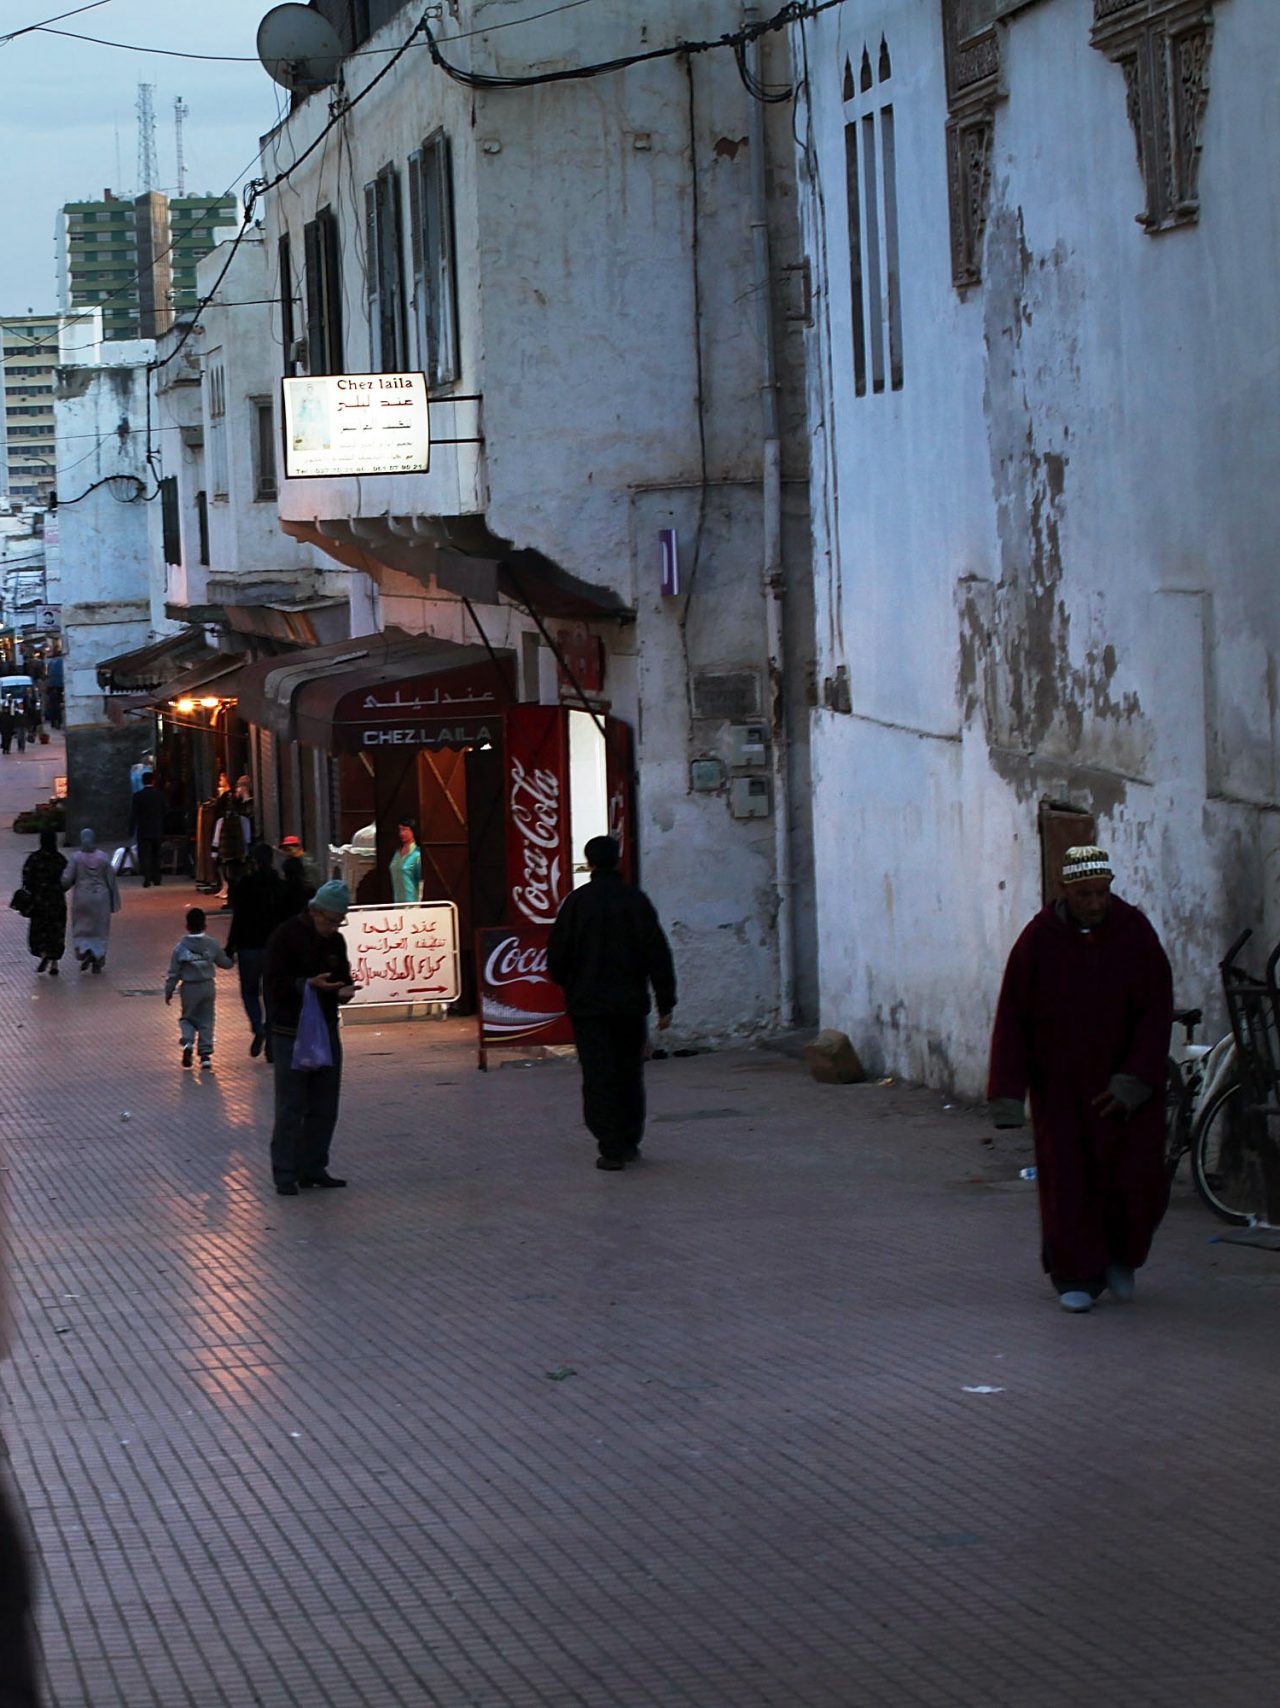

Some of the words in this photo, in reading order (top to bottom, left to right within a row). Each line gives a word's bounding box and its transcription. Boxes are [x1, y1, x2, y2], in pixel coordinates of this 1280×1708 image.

[337, 379, 373, 391] Chez
[379, 377, 414, 389] laila
[379, 396, 414, 407] عند
[419, 725, 492, 743] LAILA
[410, 920, 437, 935] عند
[417, 955, 447, 980] كراء
